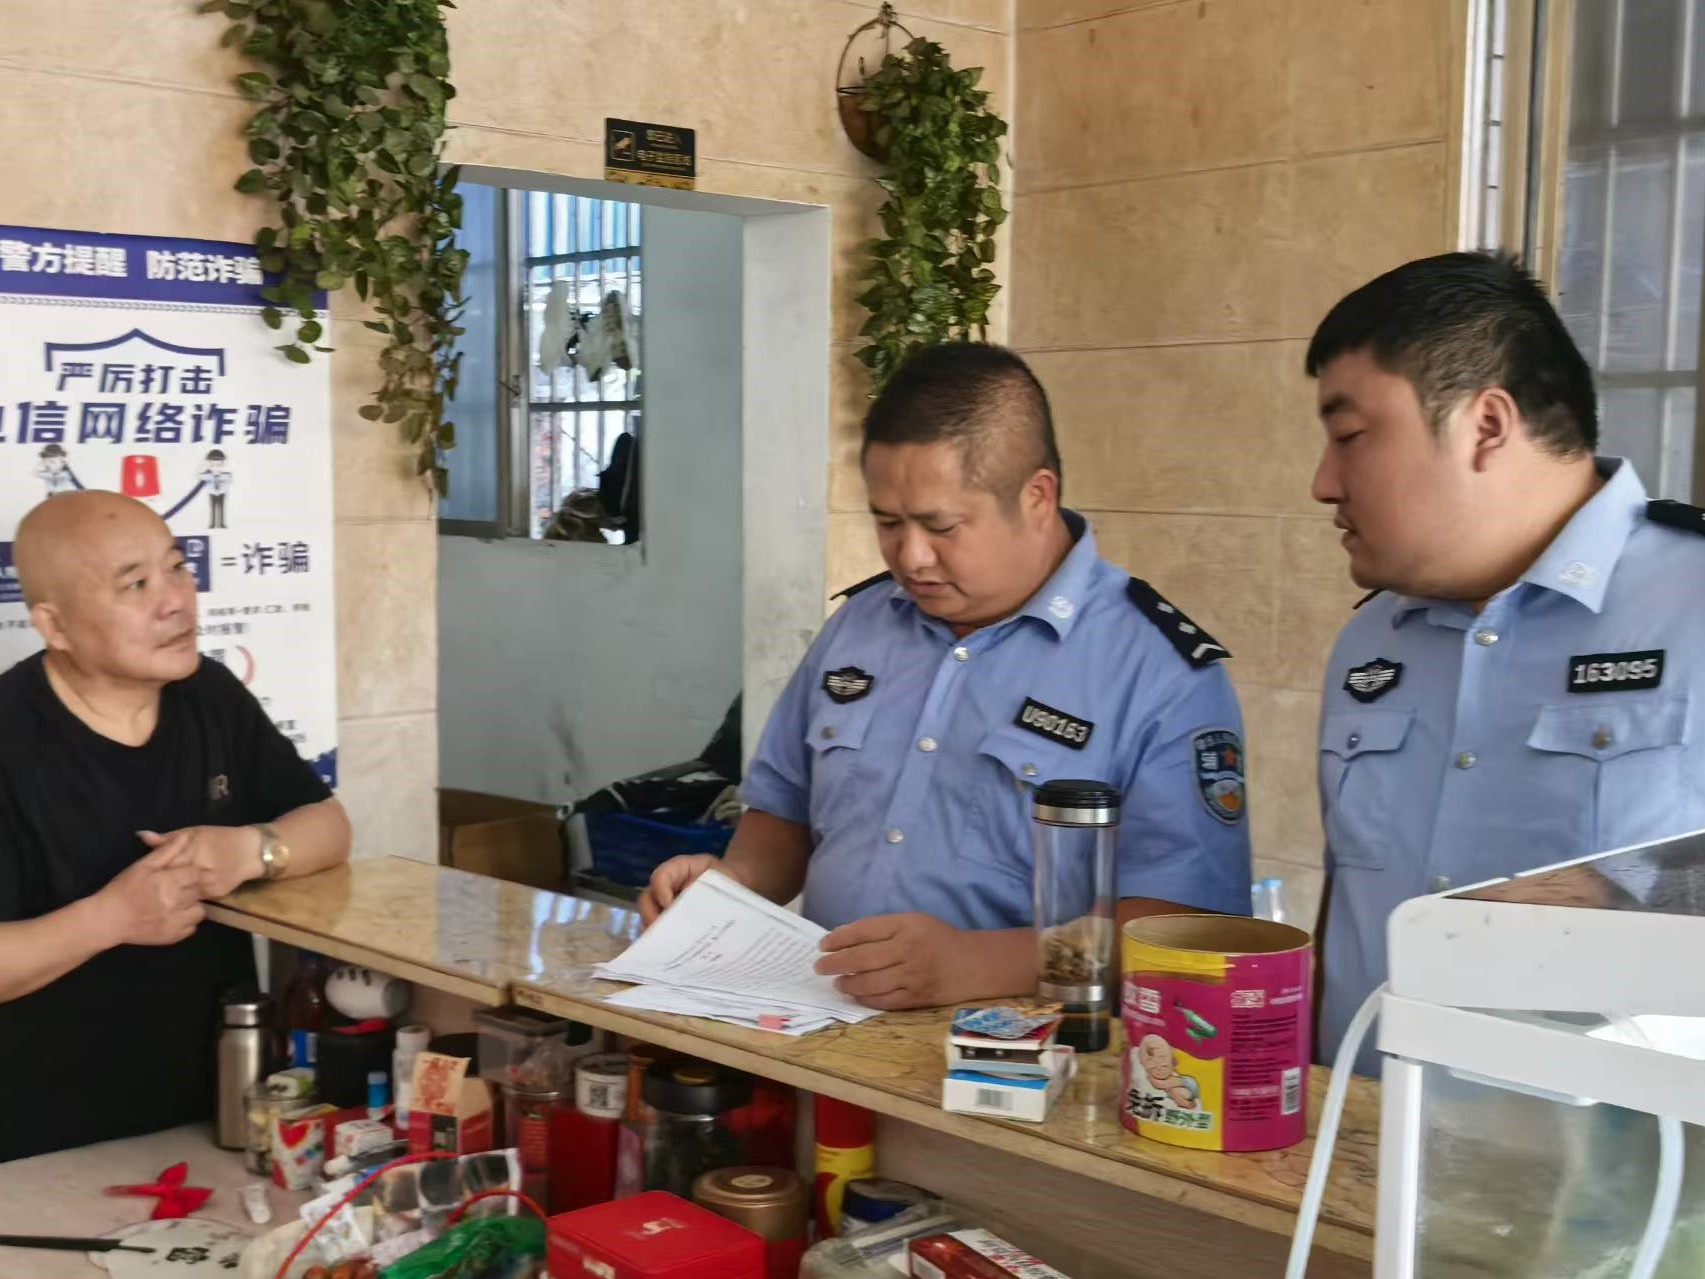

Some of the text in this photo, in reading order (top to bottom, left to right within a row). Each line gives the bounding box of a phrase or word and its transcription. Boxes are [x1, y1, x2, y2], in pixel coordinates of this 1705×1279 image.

[0, 239, 264, 286] 警方提醒 防范诈骗
[55, 362, 213, 395] 严厉打击
[0, 400, 292, 445] 信网络诈骗
